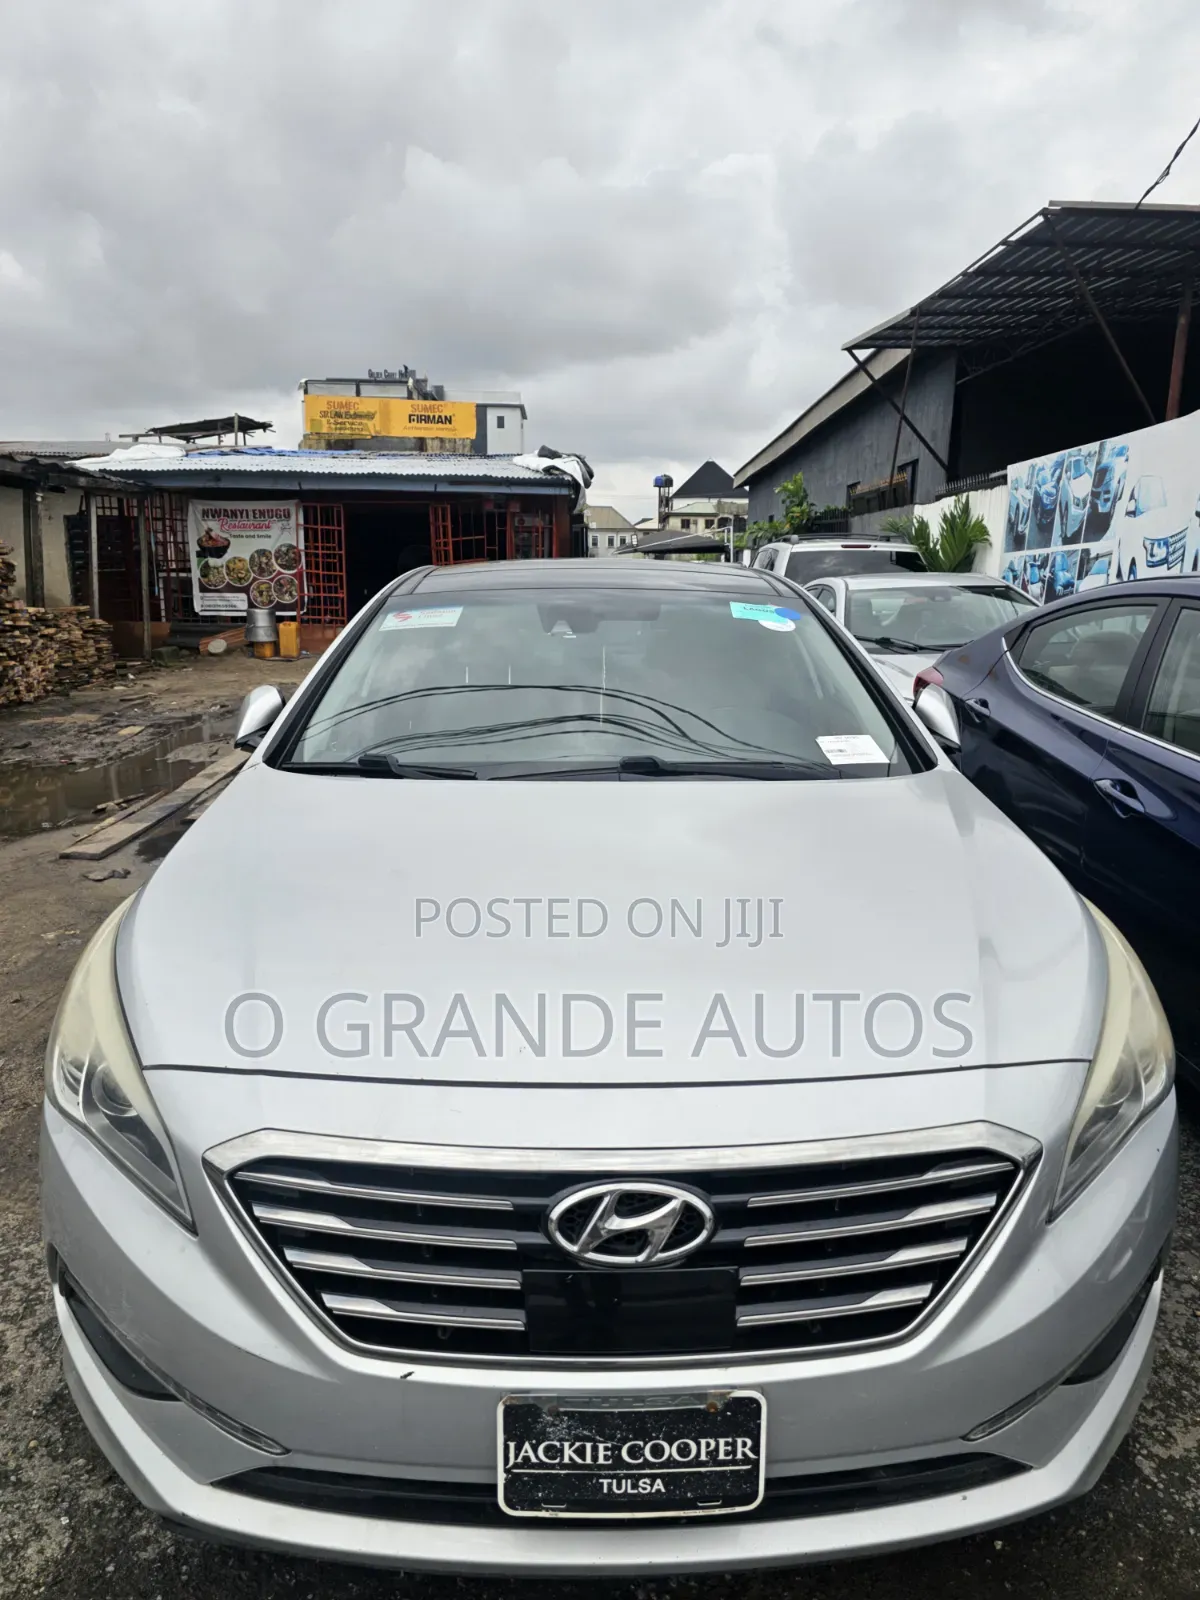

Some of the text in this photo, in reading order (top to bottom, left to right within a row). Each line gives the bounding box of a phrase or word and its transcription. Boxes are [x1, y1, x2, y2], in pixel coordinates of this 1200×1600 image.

[326, 400, 360, 411] SUMEC
[410, 403, 444, 414] SUMEC
[408, 413, 453, 425] FIRMAN
[201, 508, 291, 519] NWANYI ENUGU
[217, 517, 276, 531] Restaurant
[506, 1436, 758, 1469] JACKIE COOPER
[598, 1478, 667, 1494] TULSA
